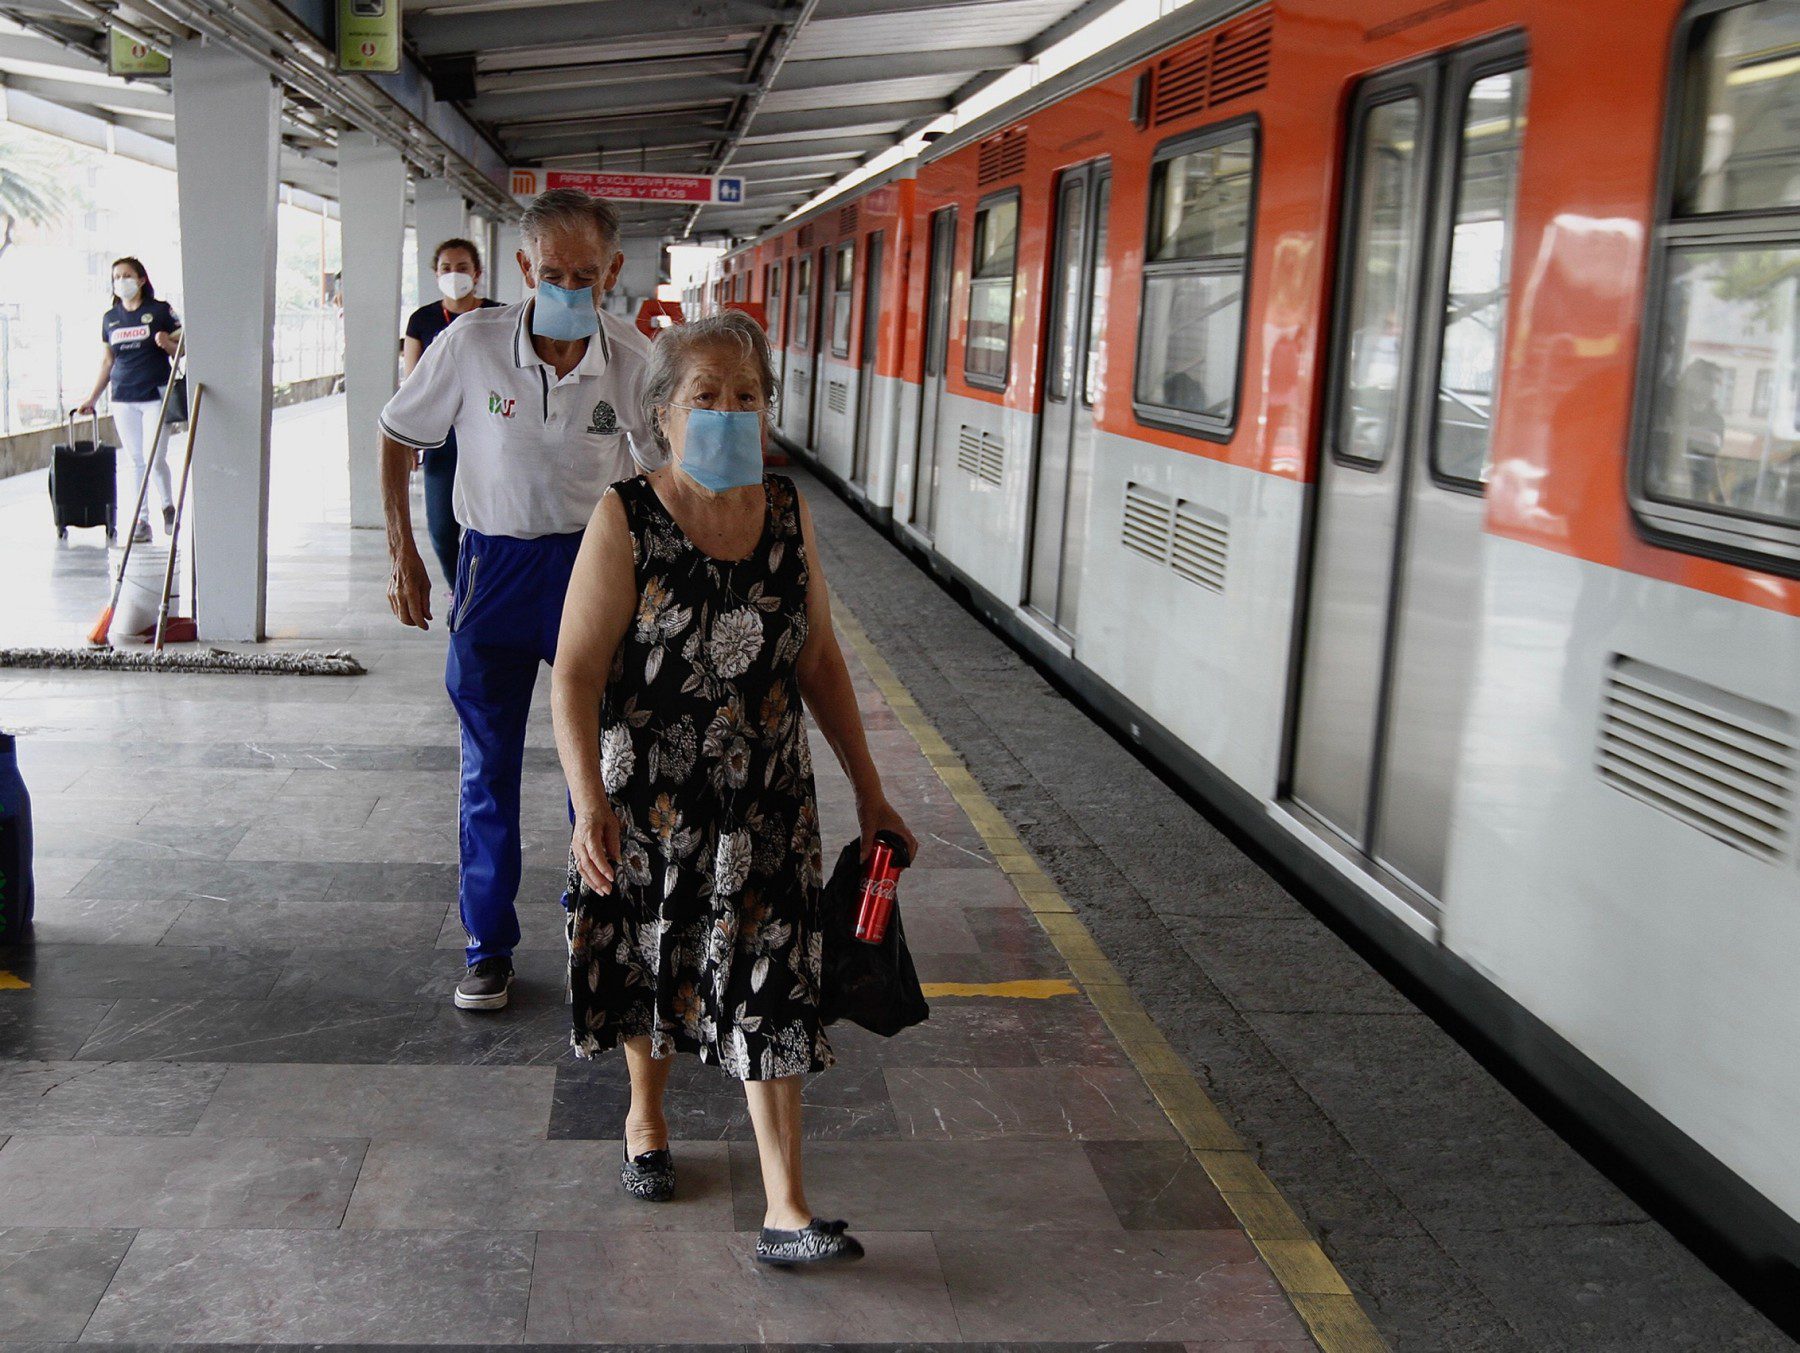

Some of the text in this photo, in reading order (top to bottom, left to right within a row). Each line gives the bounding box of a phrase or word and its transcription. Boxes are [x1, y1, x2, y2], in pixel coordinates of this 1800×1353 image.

[596, 175, 664, 186] EXCLUSIVA
[665, 178, 699, 187] PARA
[114, 328, 147, 339] BIMBO
